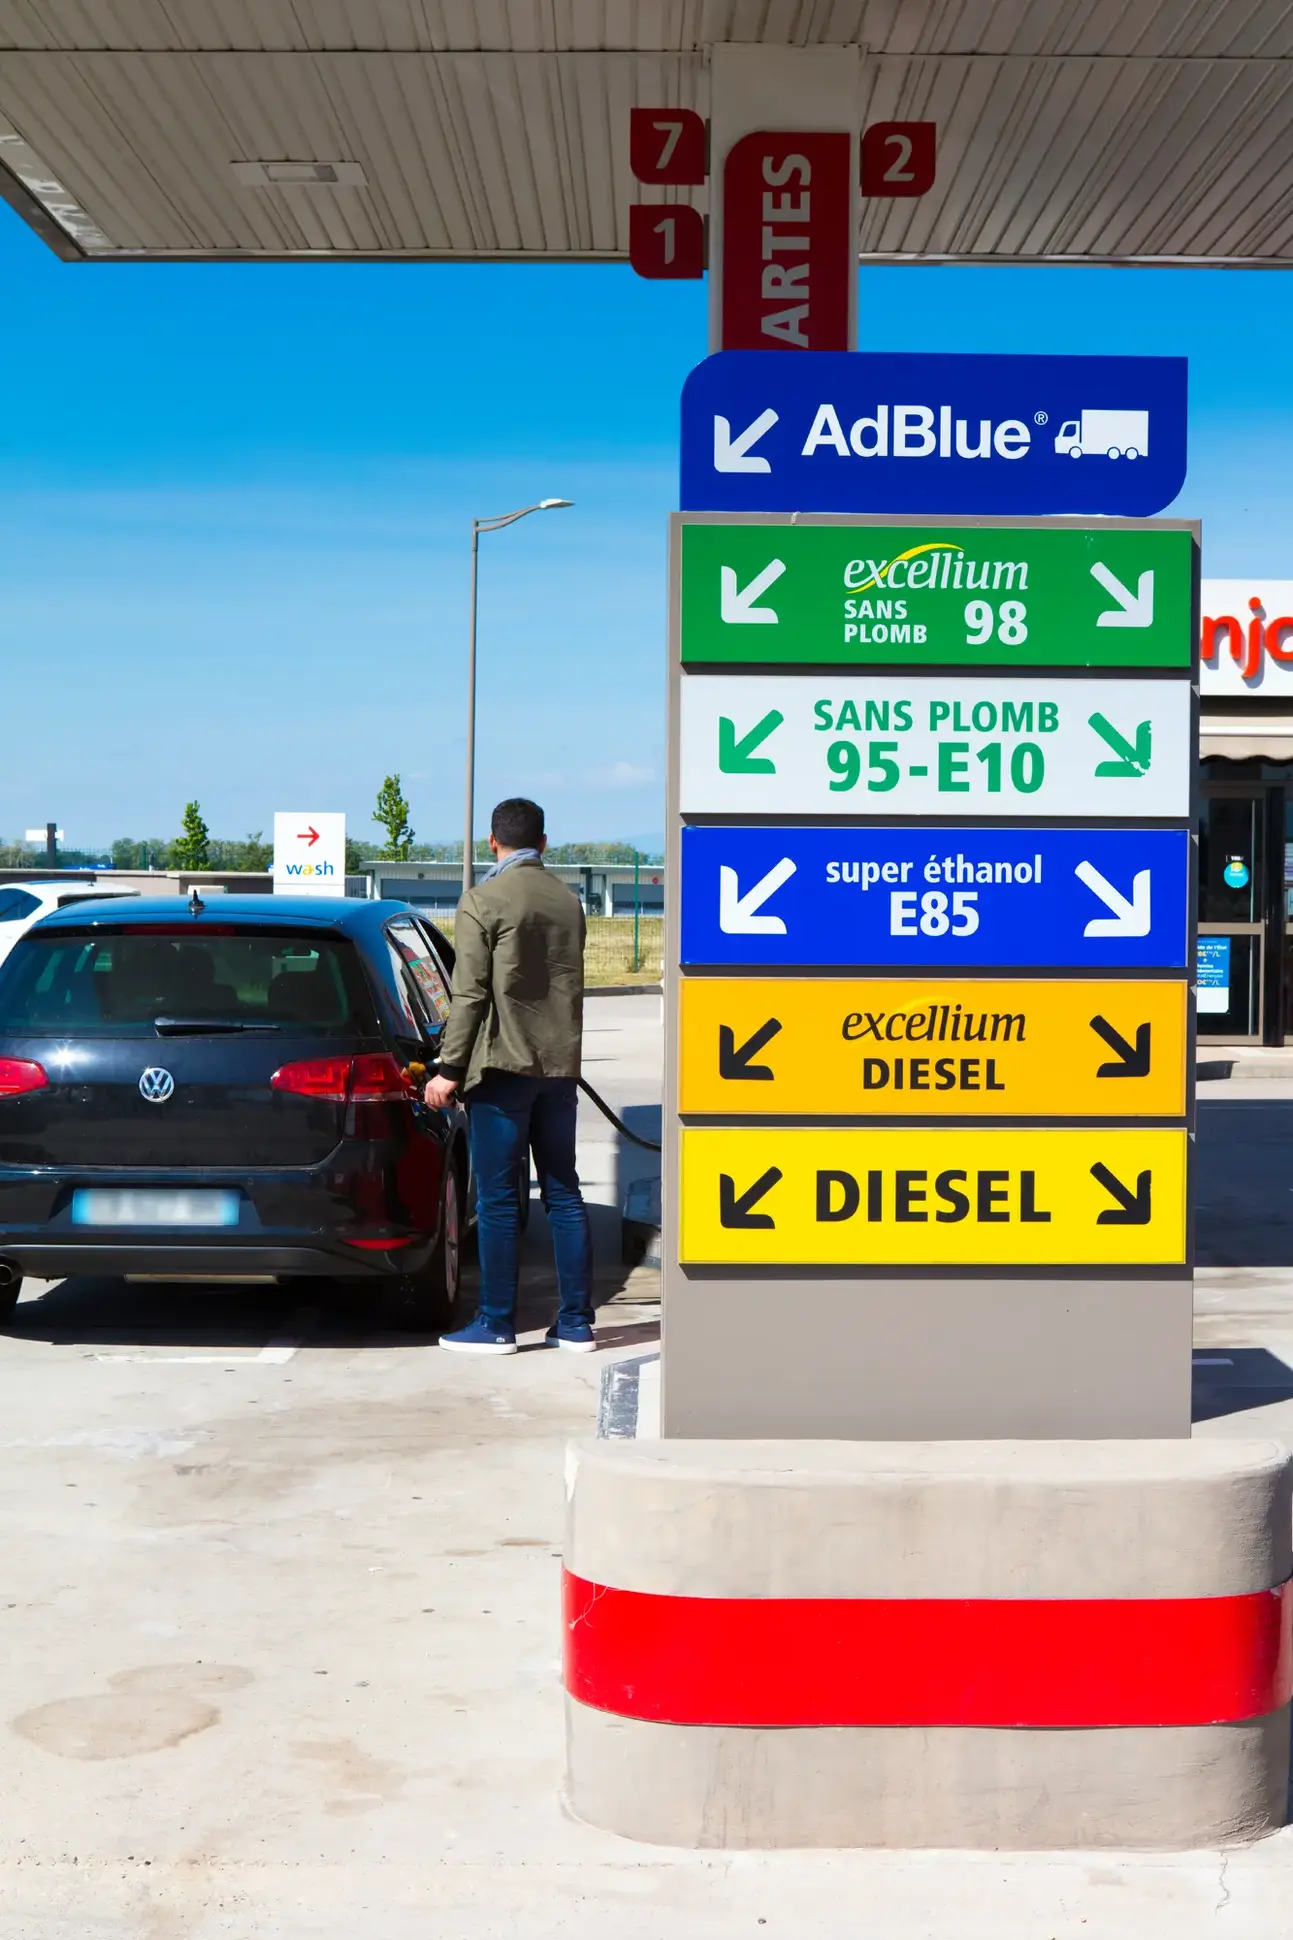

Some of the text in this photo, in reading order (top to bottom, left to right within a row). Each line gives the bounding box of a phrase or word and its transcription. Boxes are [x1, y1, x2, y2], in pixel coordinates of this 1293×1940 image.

[653, 122, 683, 169] 7
[883, 134, 915, 182] 2
[653, 218, 675, 265] 1
[843, 551, 1029, 591] excellium
[844, 599, 908, 620] SANS
[963, 599, 1029, 646] 98
[844, 623, 928, 644] PLOMB
[813, 699, 1060, 733] SANS PLOMB
[826, 740, 1045, 794] 95-E10
[285, 860, 334, 876] wash
[825, 853, 1043, 891] super éthanol
[889, 892, 980, 937] E85
[842, 1004, 1026, 1042] excellium
[863, 1057, 1006, 1091] DIESEL
[816, 1169, 1052, 1224] DIESEL
